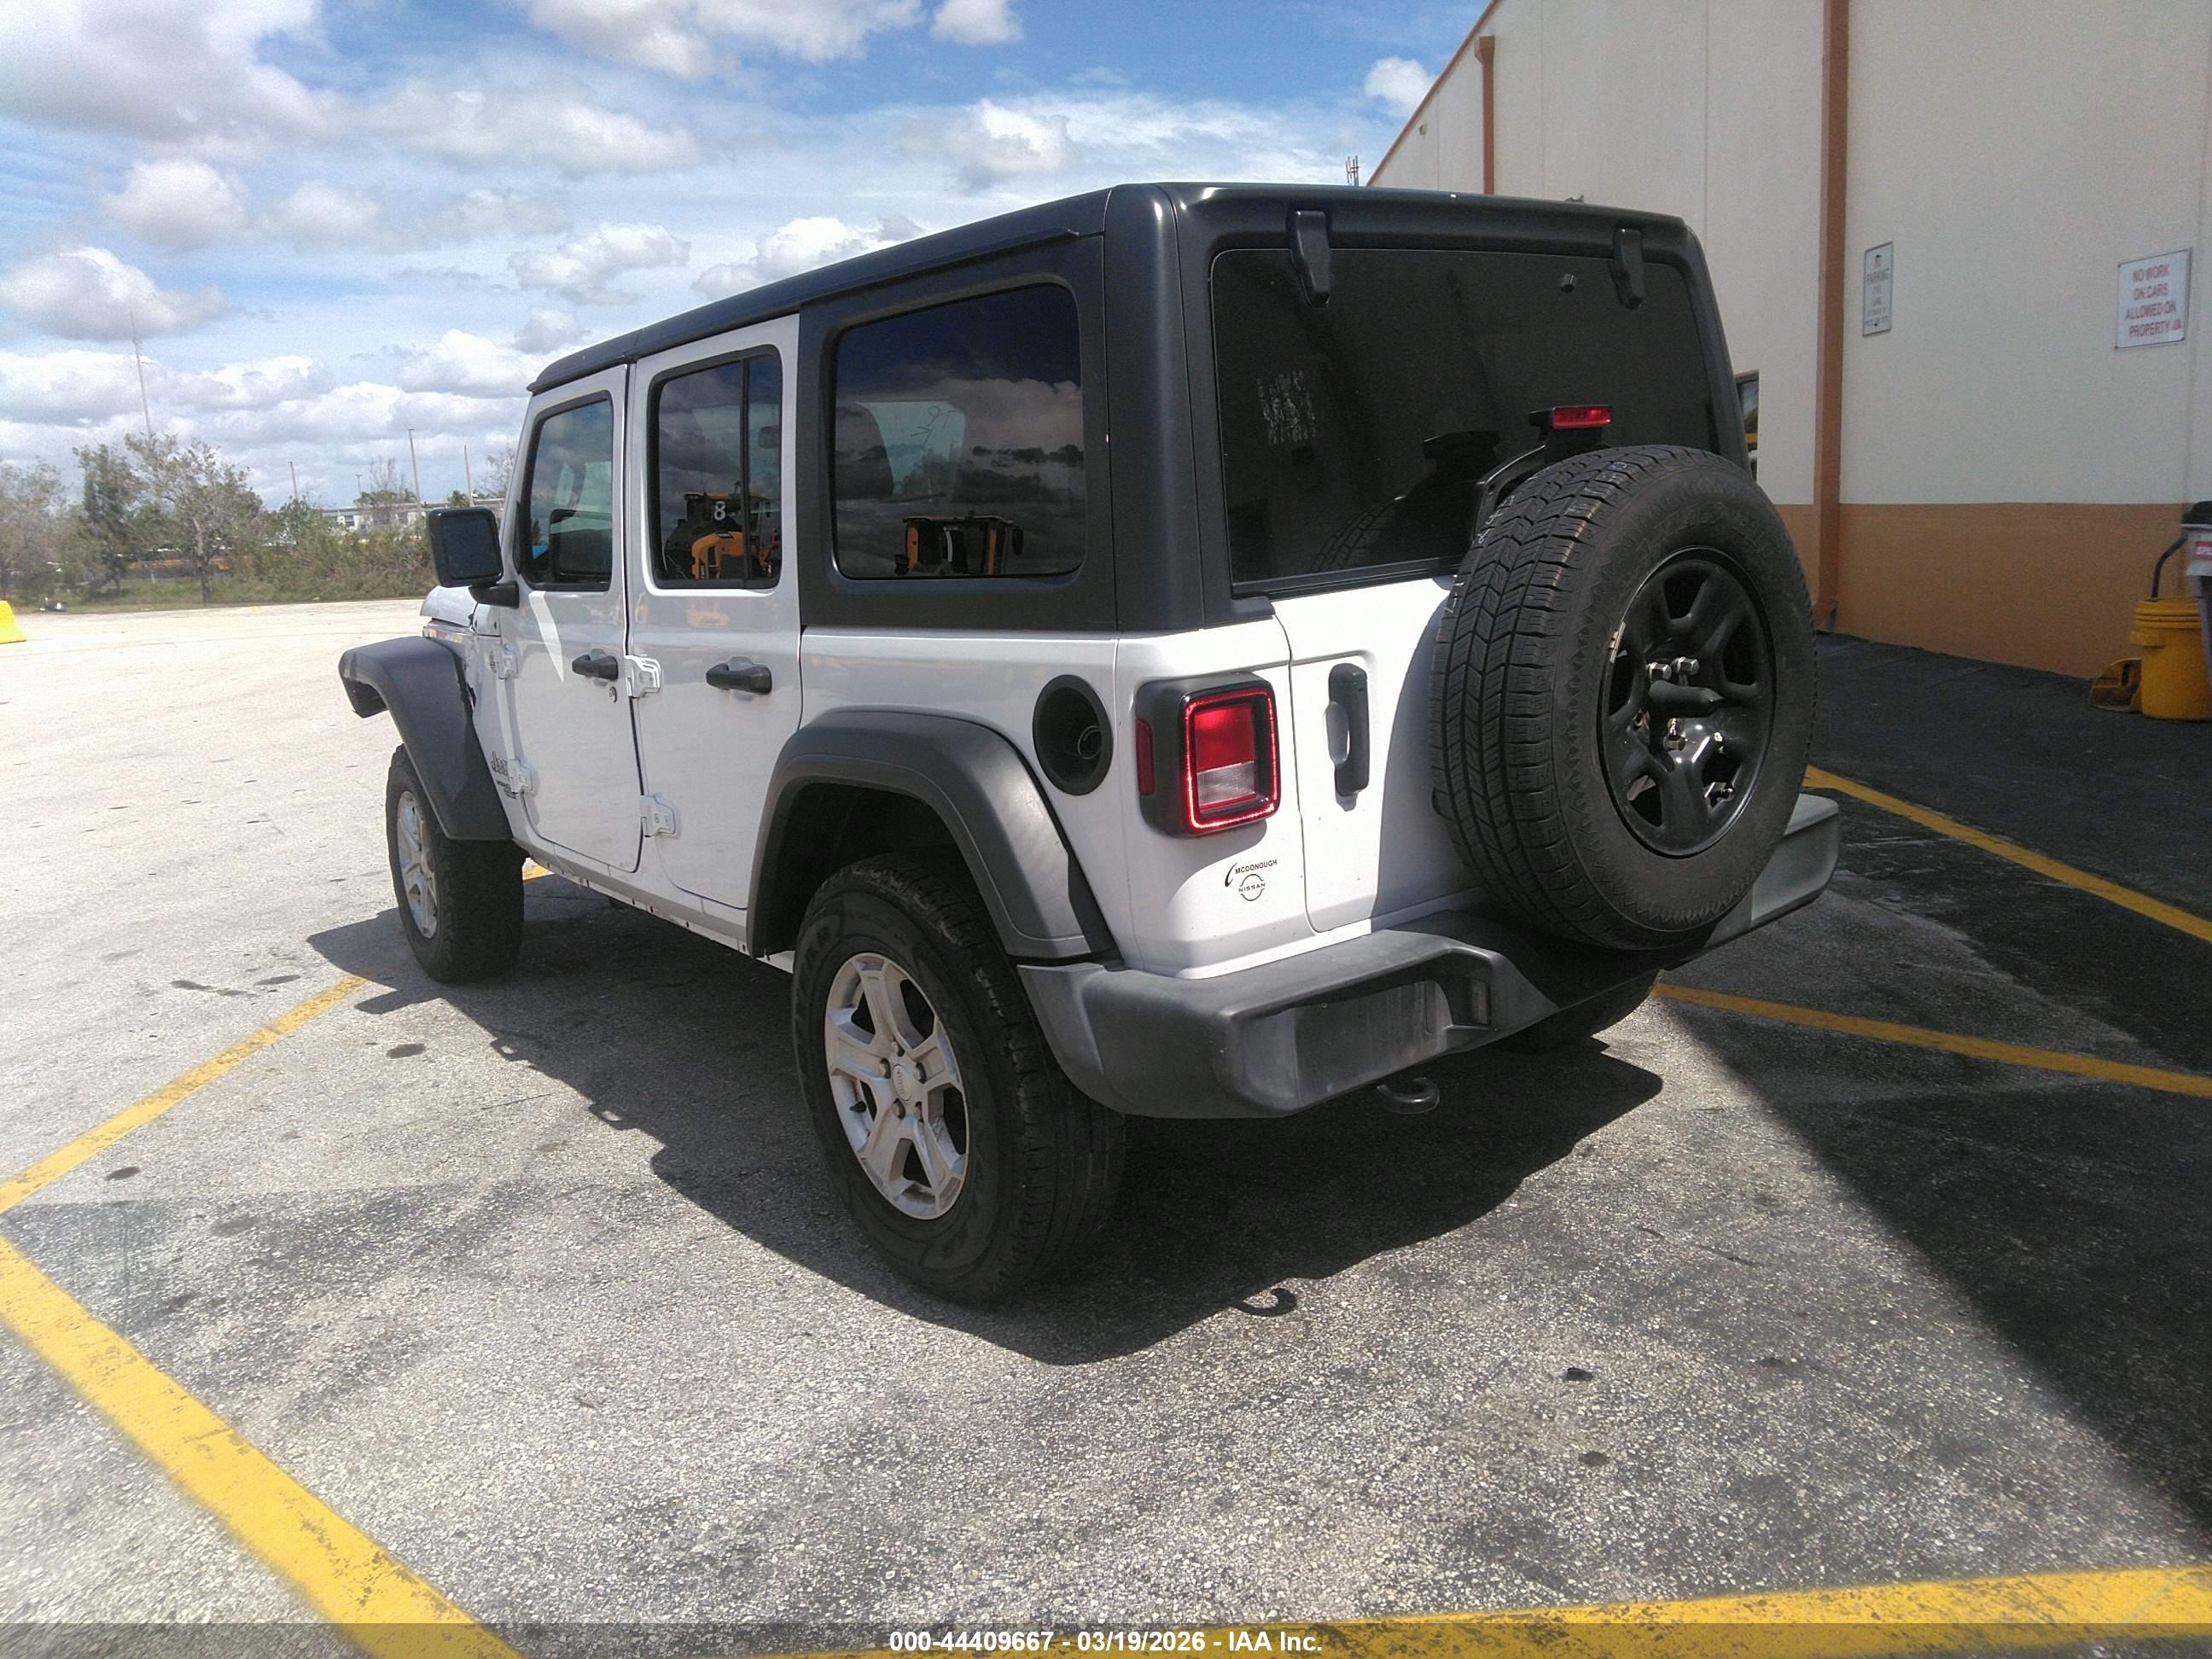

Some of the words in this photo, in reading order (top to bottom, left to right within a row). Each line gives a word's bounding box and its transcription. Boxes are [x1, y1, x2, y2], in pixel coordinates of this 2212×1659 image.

[2133, 268, 2144, 282] NO
[2133, 287, 2145, 300] ON
[2147, 282, 2168, 299] CARS
[2125, 302, 2163, 320] ALLOWED
[2165, 300, 2176, 314] ON
[2129, 320, 2171, 337] PROPERTY
[1235, 859, 1278, 875] MCDONOUGH
[1238, 882, 1266, 893] NISSAN
